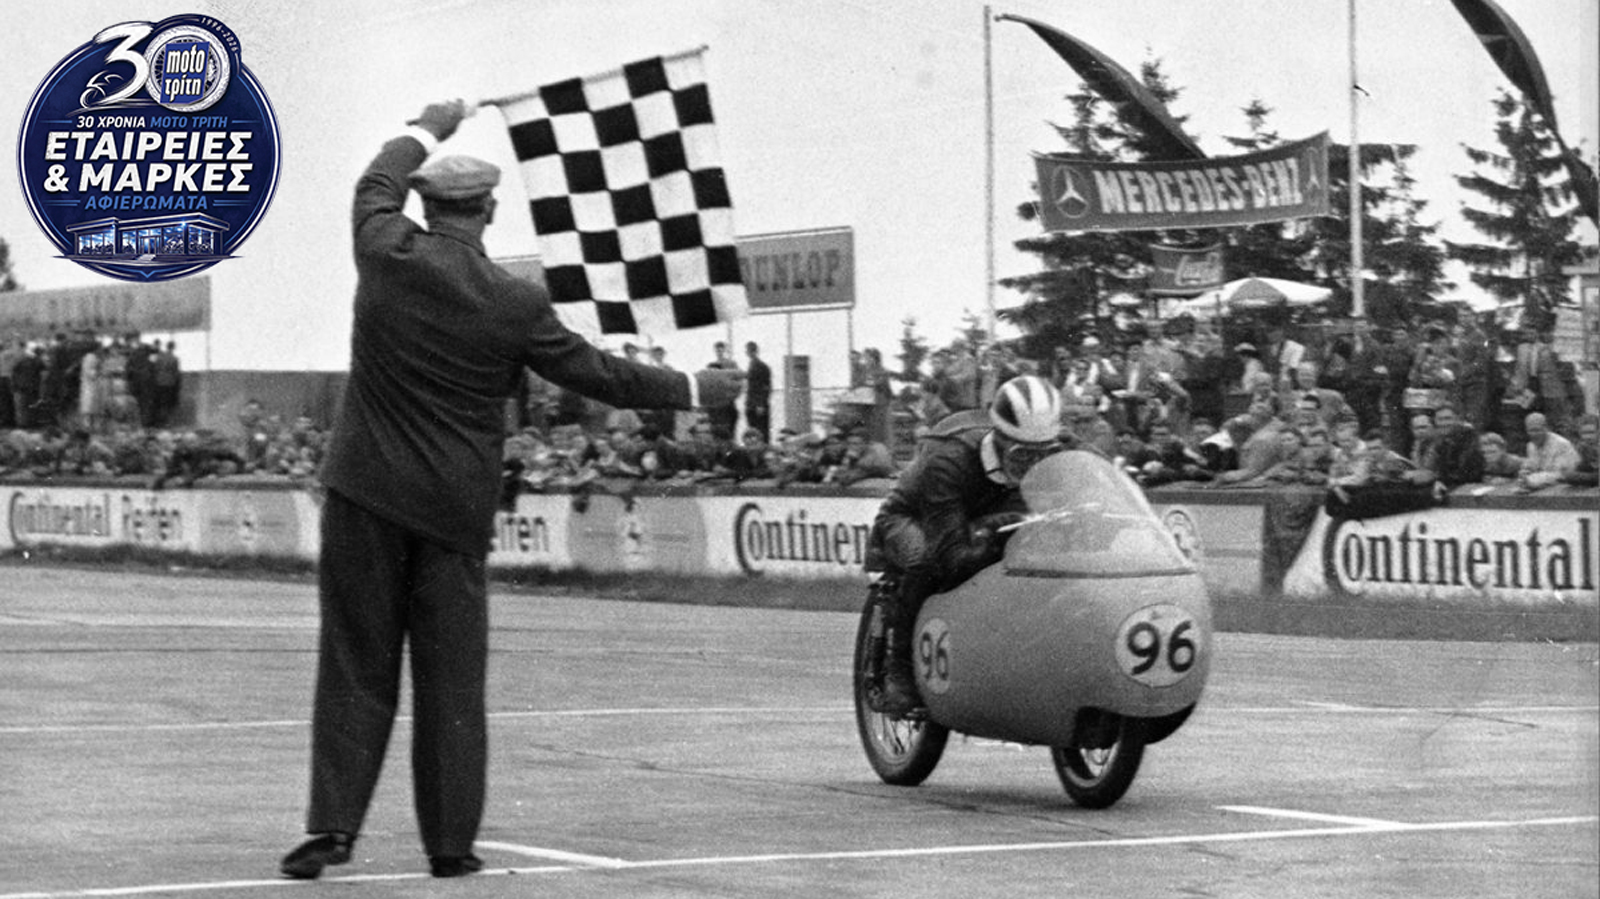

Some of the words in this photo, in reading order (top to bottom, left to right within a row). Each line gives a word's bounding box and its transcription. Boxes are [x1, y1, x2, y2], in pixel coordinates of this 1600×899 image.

[1322, 517, 1593, 592] Continental
[919, 631, 949, 681] 96
[1127, 621, 1196, 675] 96
